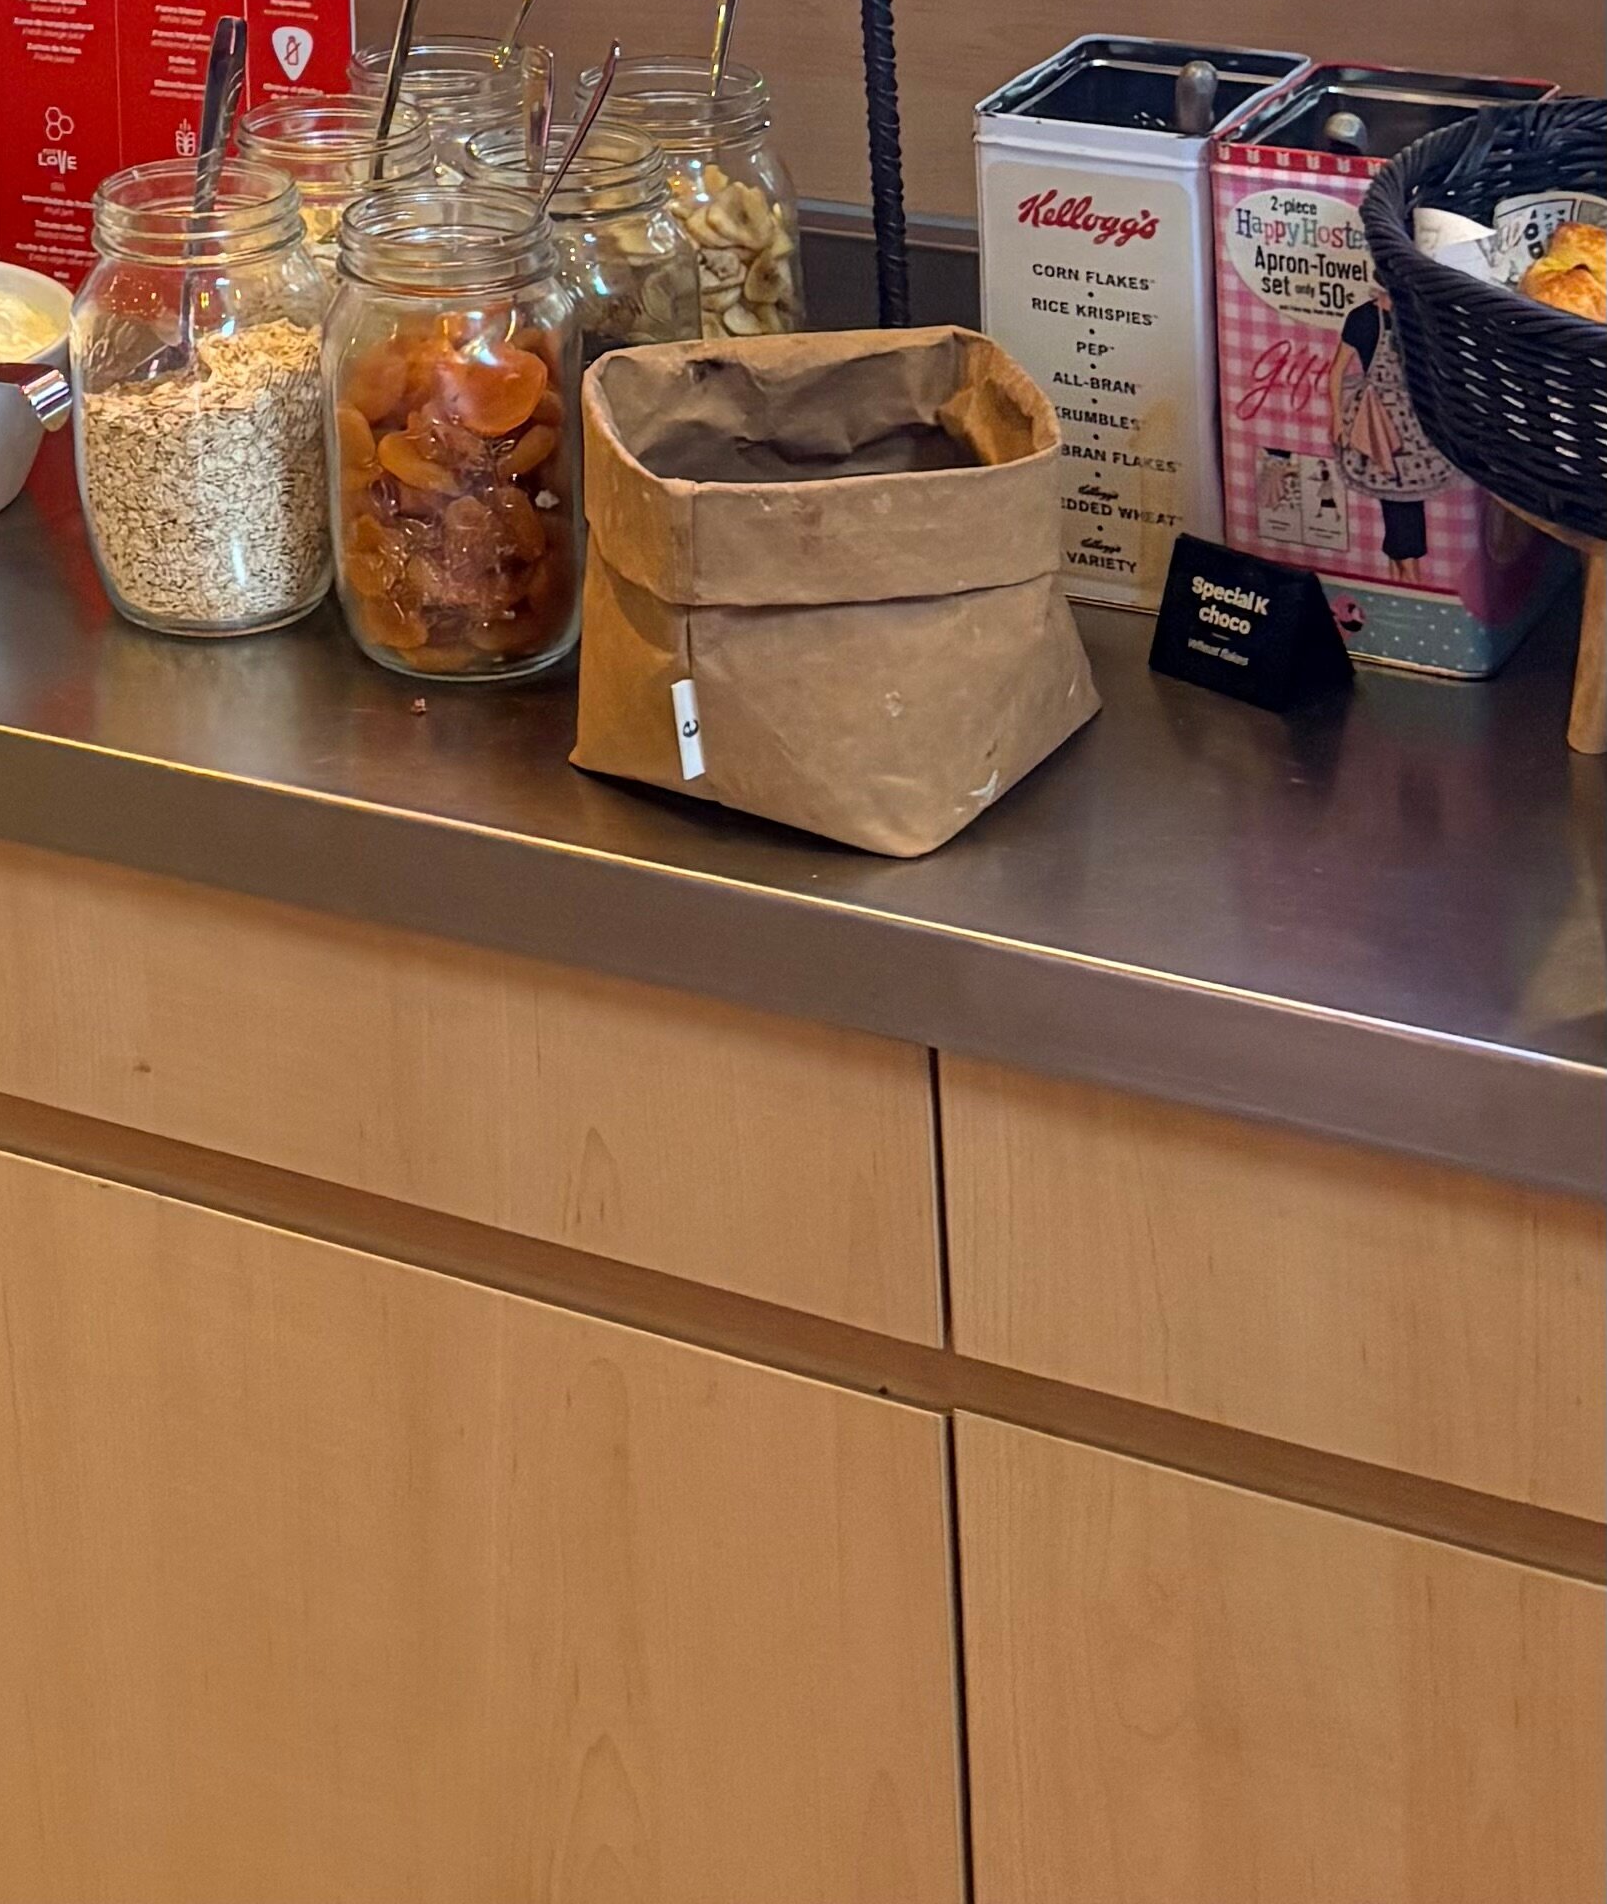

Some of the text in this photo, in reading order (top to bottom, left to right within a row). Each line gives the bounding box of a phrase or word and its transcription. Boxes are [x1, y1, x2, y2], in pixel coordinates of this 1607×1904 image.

[37, 150, 78, 175] LOVE
[1018, 189, 1160, 247] Kellogg's
[1271, 196, 1317, 216] 2-piece
[1236, 208, 1370, 251] Happy Hoste
[1032, 263, 1079, 283] CORN
[1254, 245, 1368, 282] Apron-Towel
[1261, 275, 1291, 297] set
[1031, 297, 1153, 327] RICE KRISPIES
[1076, 341, 1109, 357] PEP
[1052, 371, 1137, 396] ALL-BRAN
[1061, 443, 1107, 463] BRAN
[1066, 551, 1137, 574] VARIETY
[1191, 575, 1271, 616] Special K
[1198, 604, 1252, 635] choco
